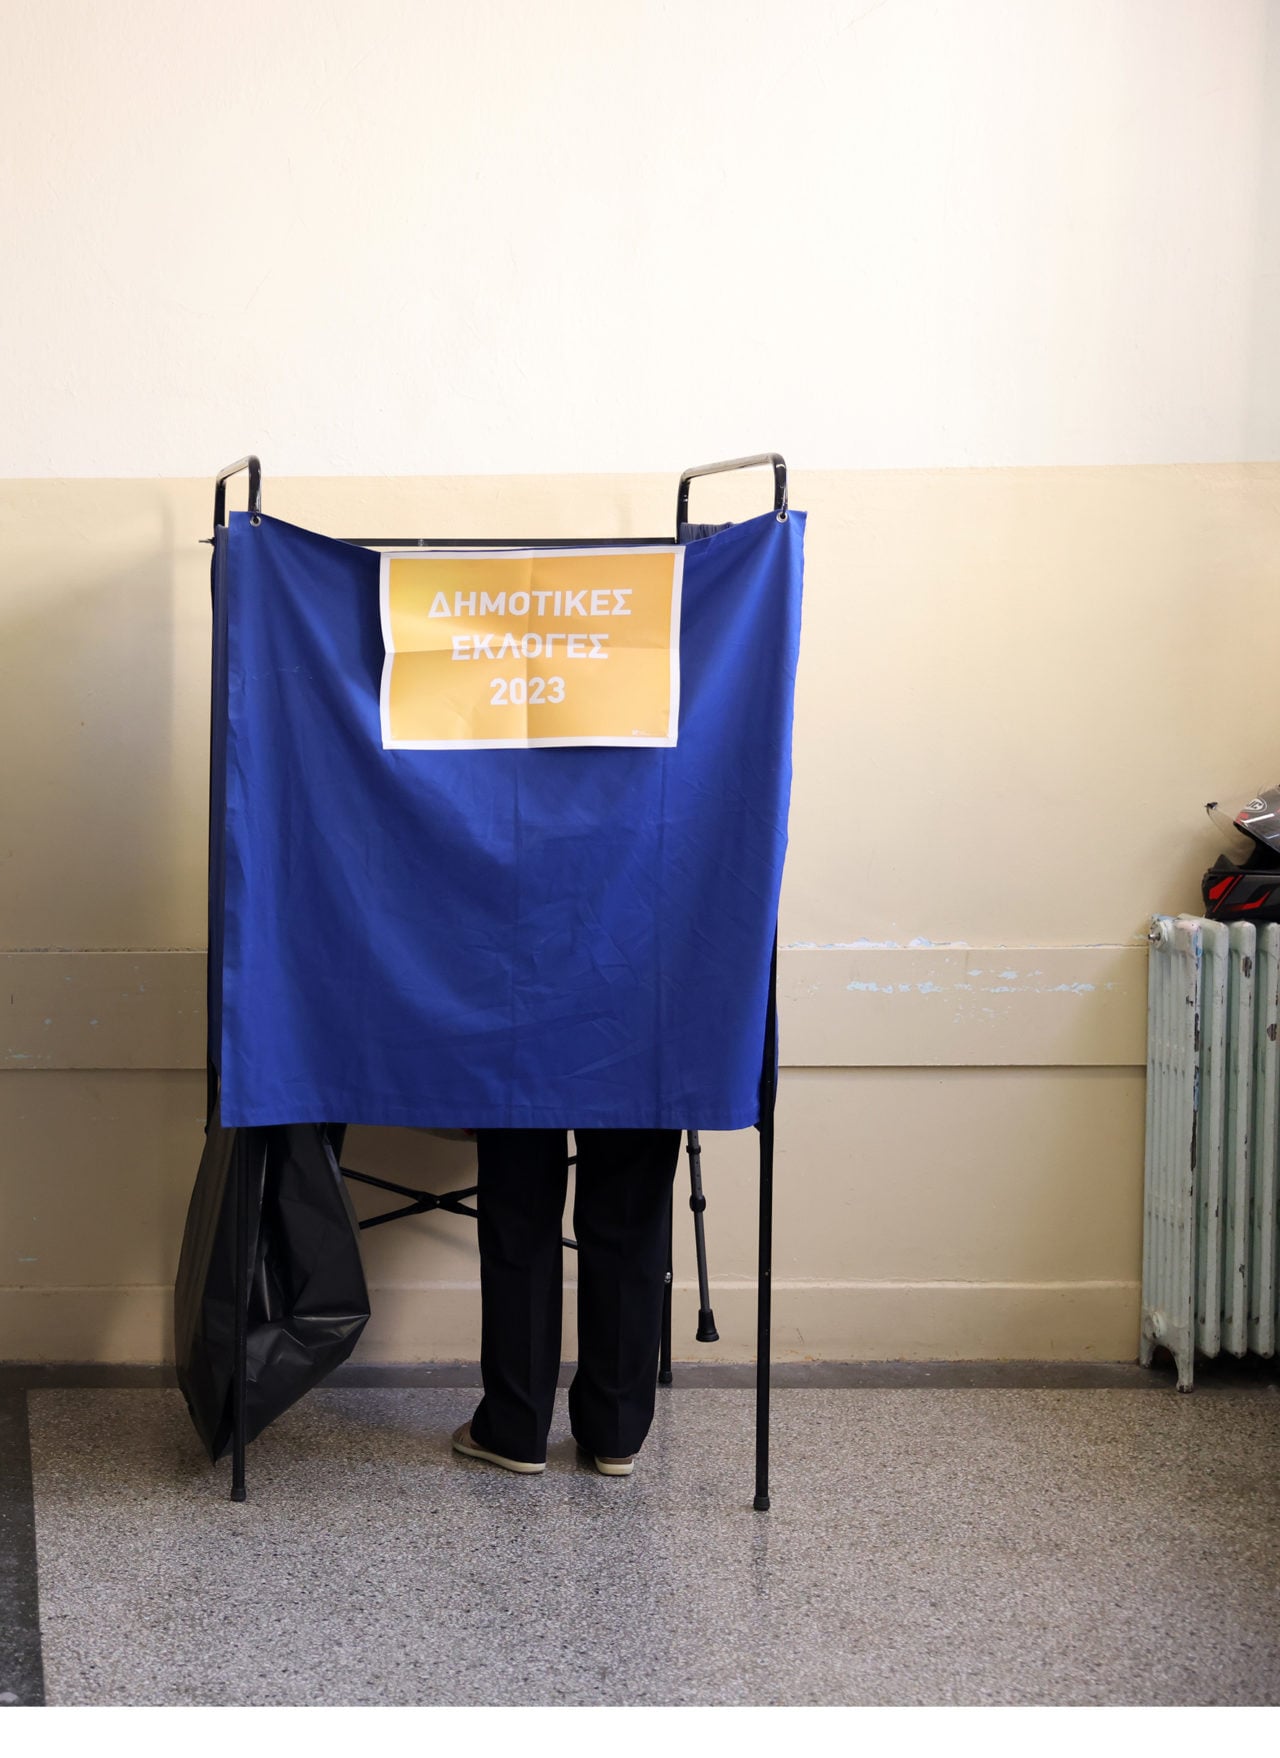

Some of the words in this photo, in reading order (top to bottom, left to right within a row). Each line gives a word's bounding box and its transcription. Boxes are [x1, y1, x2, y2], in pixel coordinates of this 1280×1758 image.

[427, 588, 633, 618] ΔΗΜΟΤΙΚΕΣ
[451, 632, 609, 661] ΕΚΛΟΓΕΣ
[489, 676, 566, 705] 2023
